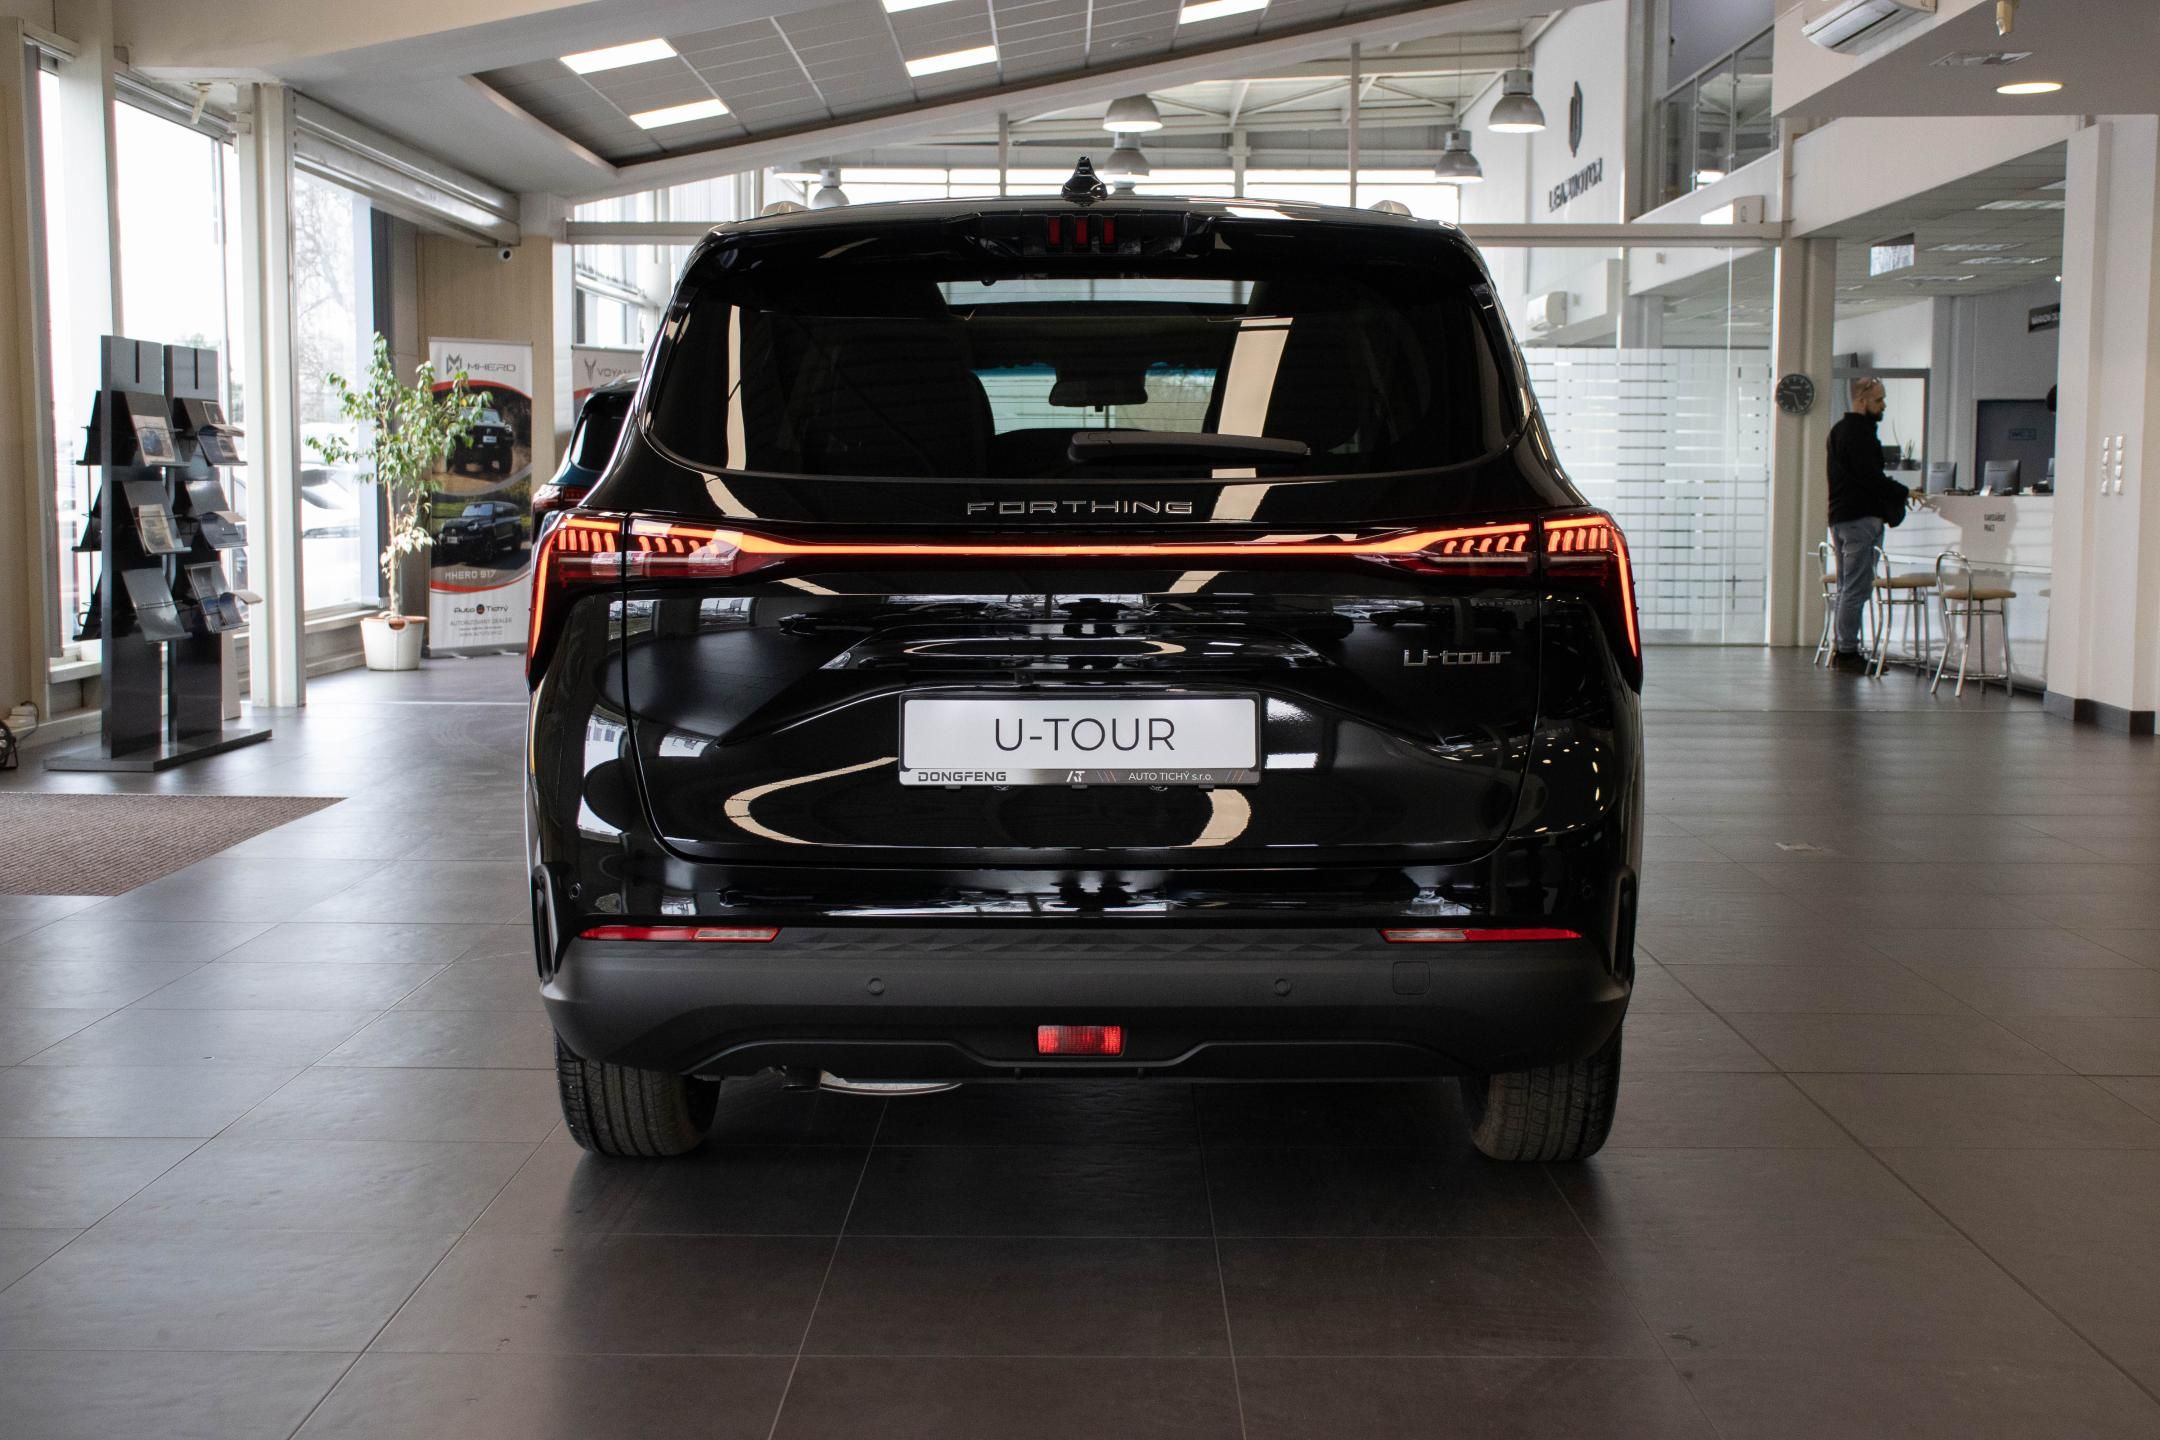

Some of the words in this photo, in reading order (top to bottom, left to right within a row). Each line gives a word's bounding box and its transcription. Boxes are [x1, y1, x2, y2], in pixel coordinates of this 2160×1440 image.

[467, 362, 516, 373] MHERO
[967, 500, 1192, 515] FORTHING
[995, 718, 1175, 751] U-TOUR
[918, 771, 1006, 782] DONGFENG
[1128, 772, 1157, 780] AUTO
[1160, 771, 1189, 780] TICHÝ
[1191, 773, 1213, 781] s.r.o.
